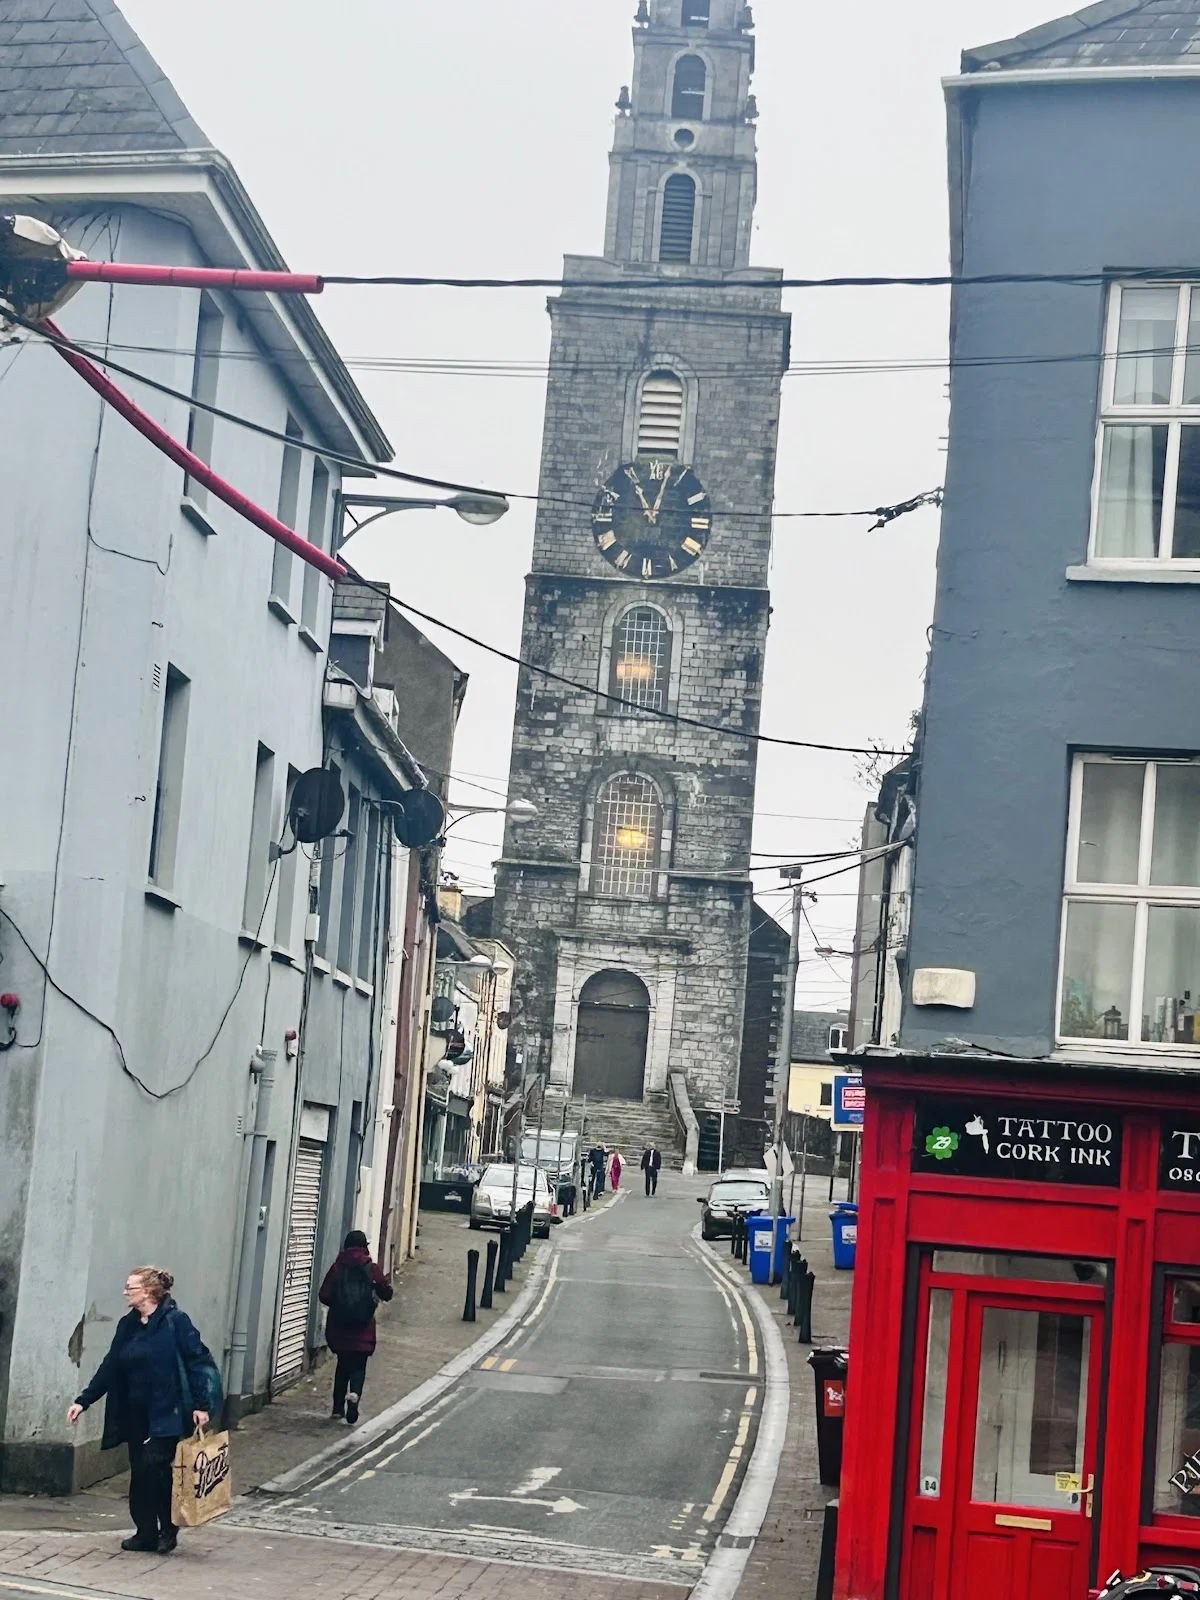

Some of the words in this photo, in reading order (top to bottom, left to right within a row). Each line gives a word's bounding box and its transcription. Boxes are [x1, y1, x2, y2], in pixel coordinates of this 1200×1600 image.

[997, 1117, 1112, 1143] TATTOO
[996, 1142, 1061, 1163] CORK
[1070, 1147, 1111, 1167] INK
